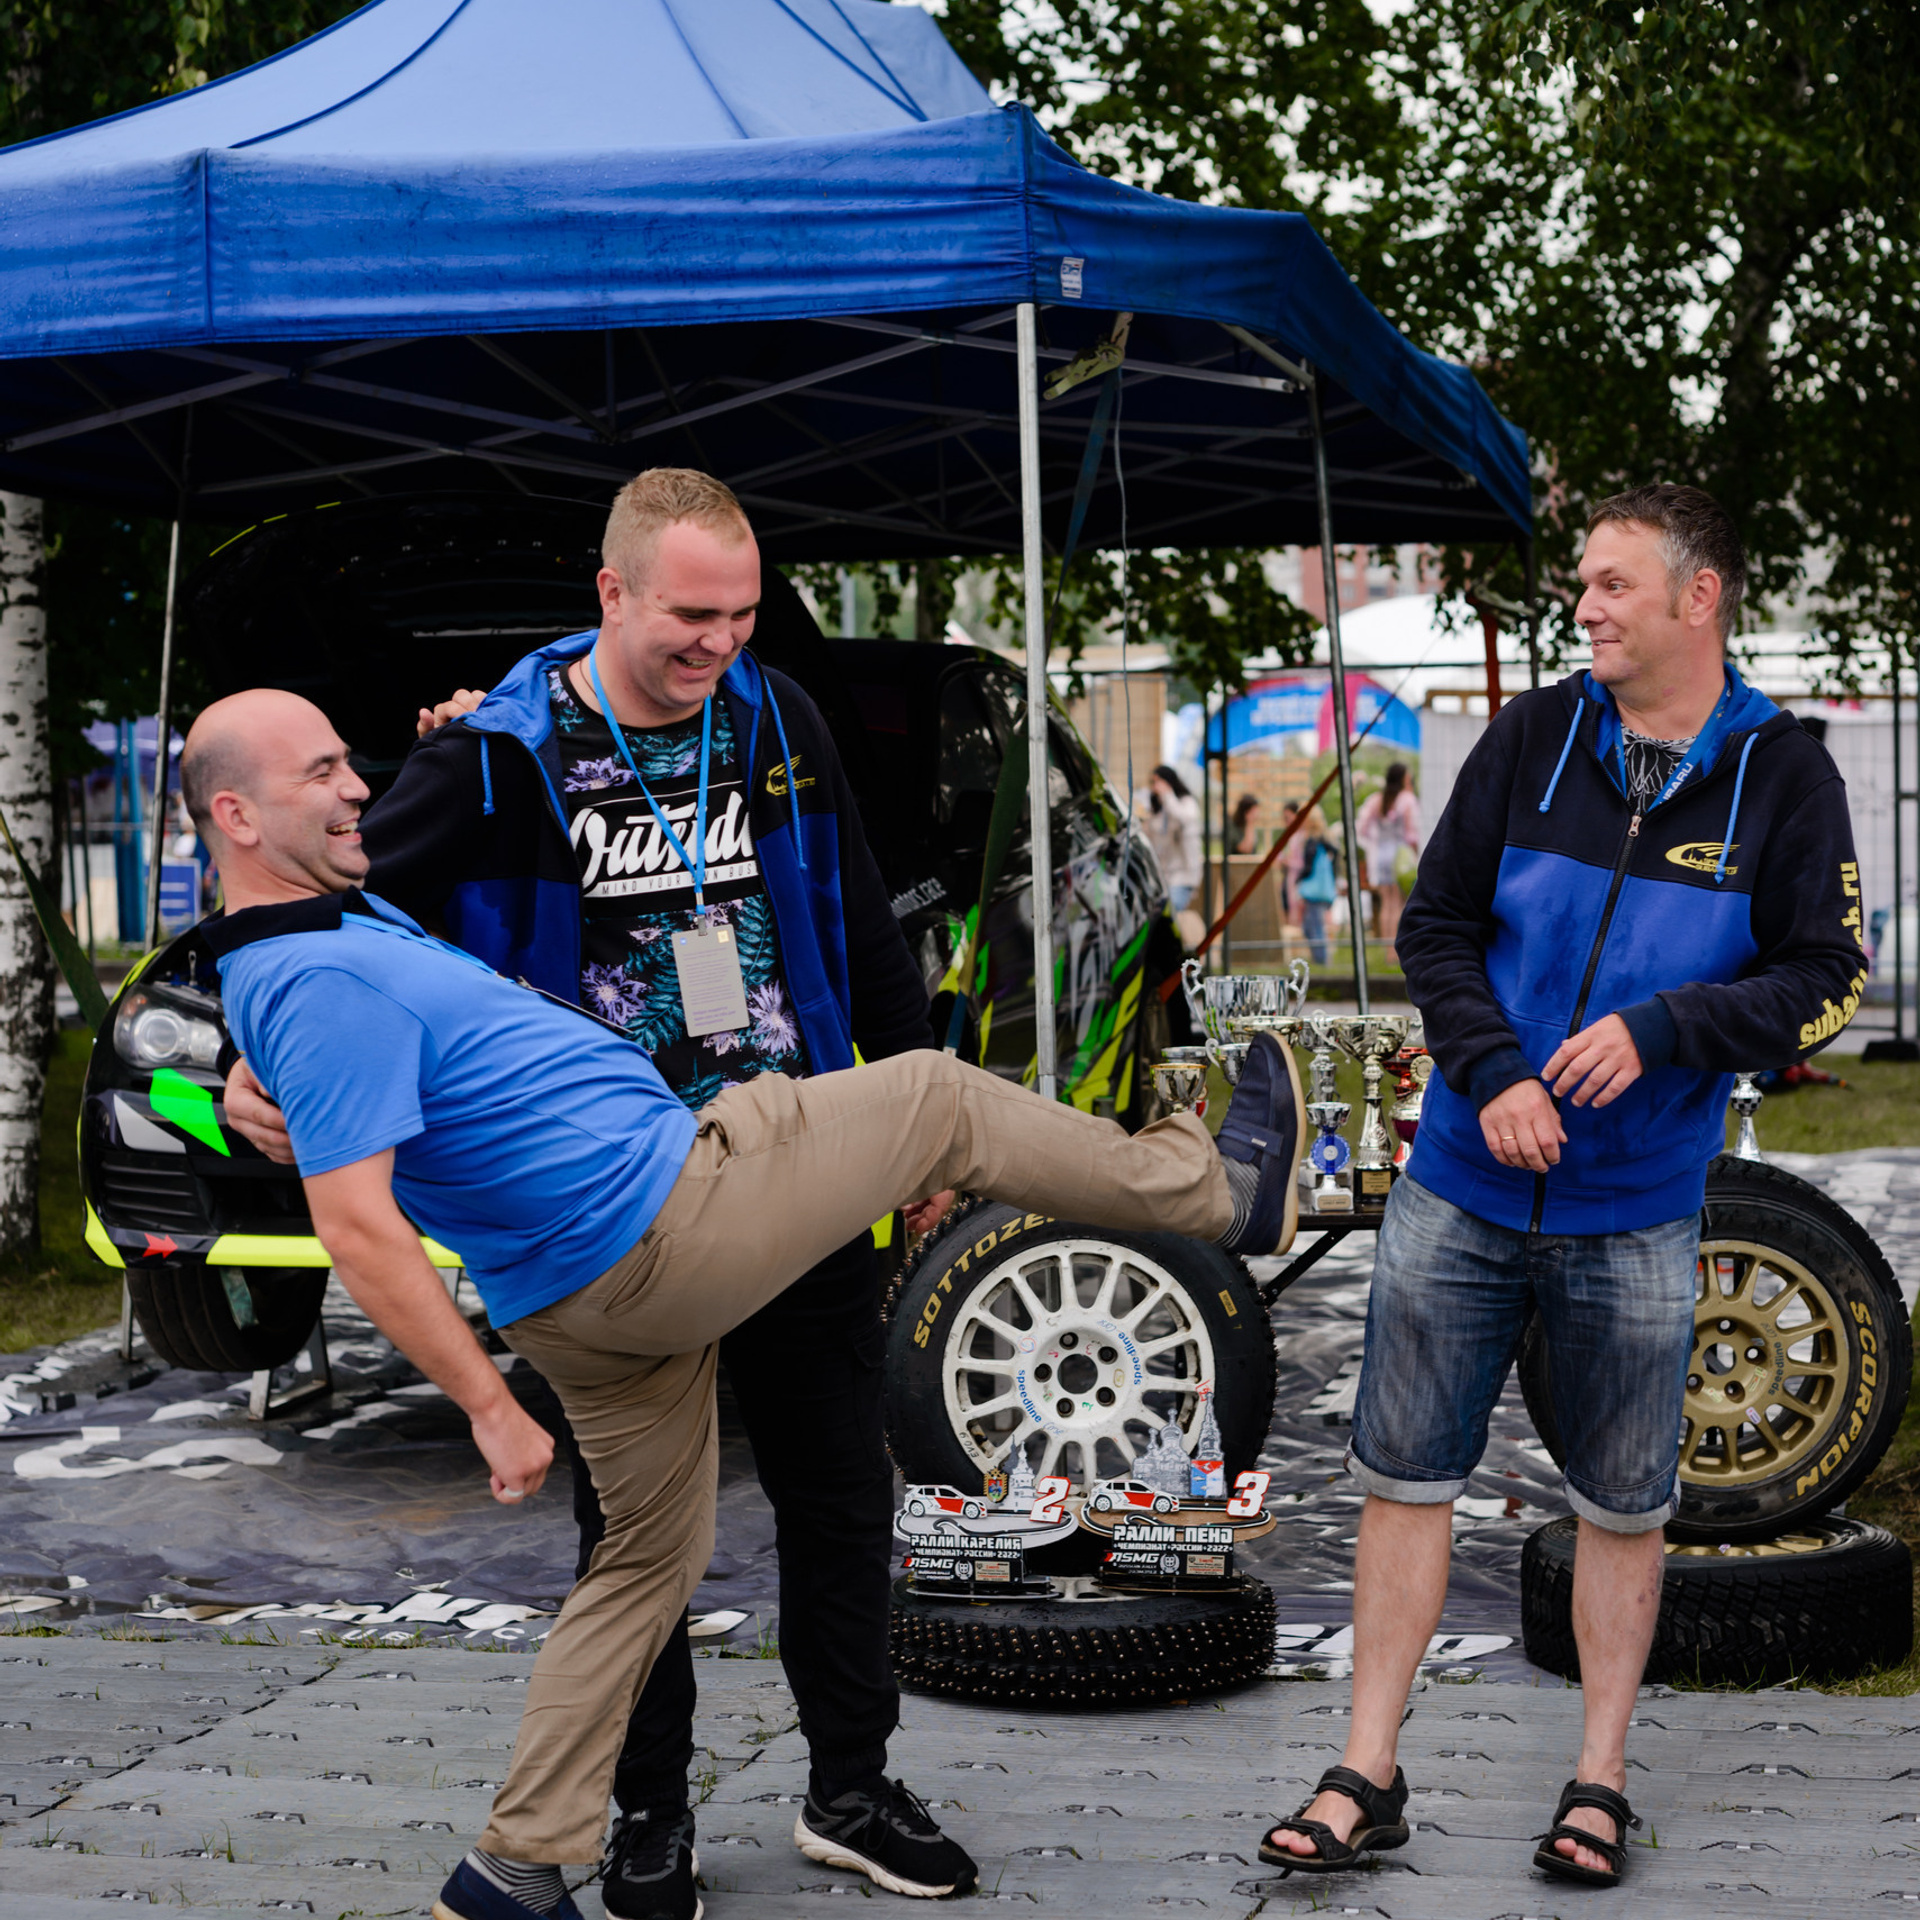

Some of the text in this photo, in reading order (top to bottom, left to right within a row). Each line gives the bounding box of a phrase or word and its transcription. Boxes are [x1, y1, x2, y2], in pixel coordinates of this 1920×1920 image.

[602, 881, 637, 895] MIND
[648, 875, 681, 889] YOUR
[913, 1213, 1055, 1349] SOTTOZE
[1118, 1332, 1143, 1385] speedline
[1768, 1341, 1783, 1396] speedline
[1016, 1369, 1042, 1423] speedline
[1796, 1301, 1877, 1497] SCORPION
[1030, 1476, 1071, 1523] 2
[1227, 1471, 1271, 1518] 3
[911, 1535, 1021, 1550] РАЛЛИ КАРЕЛИЯ
[1114, 1525, 1176, 1542] РАЛЛИ
